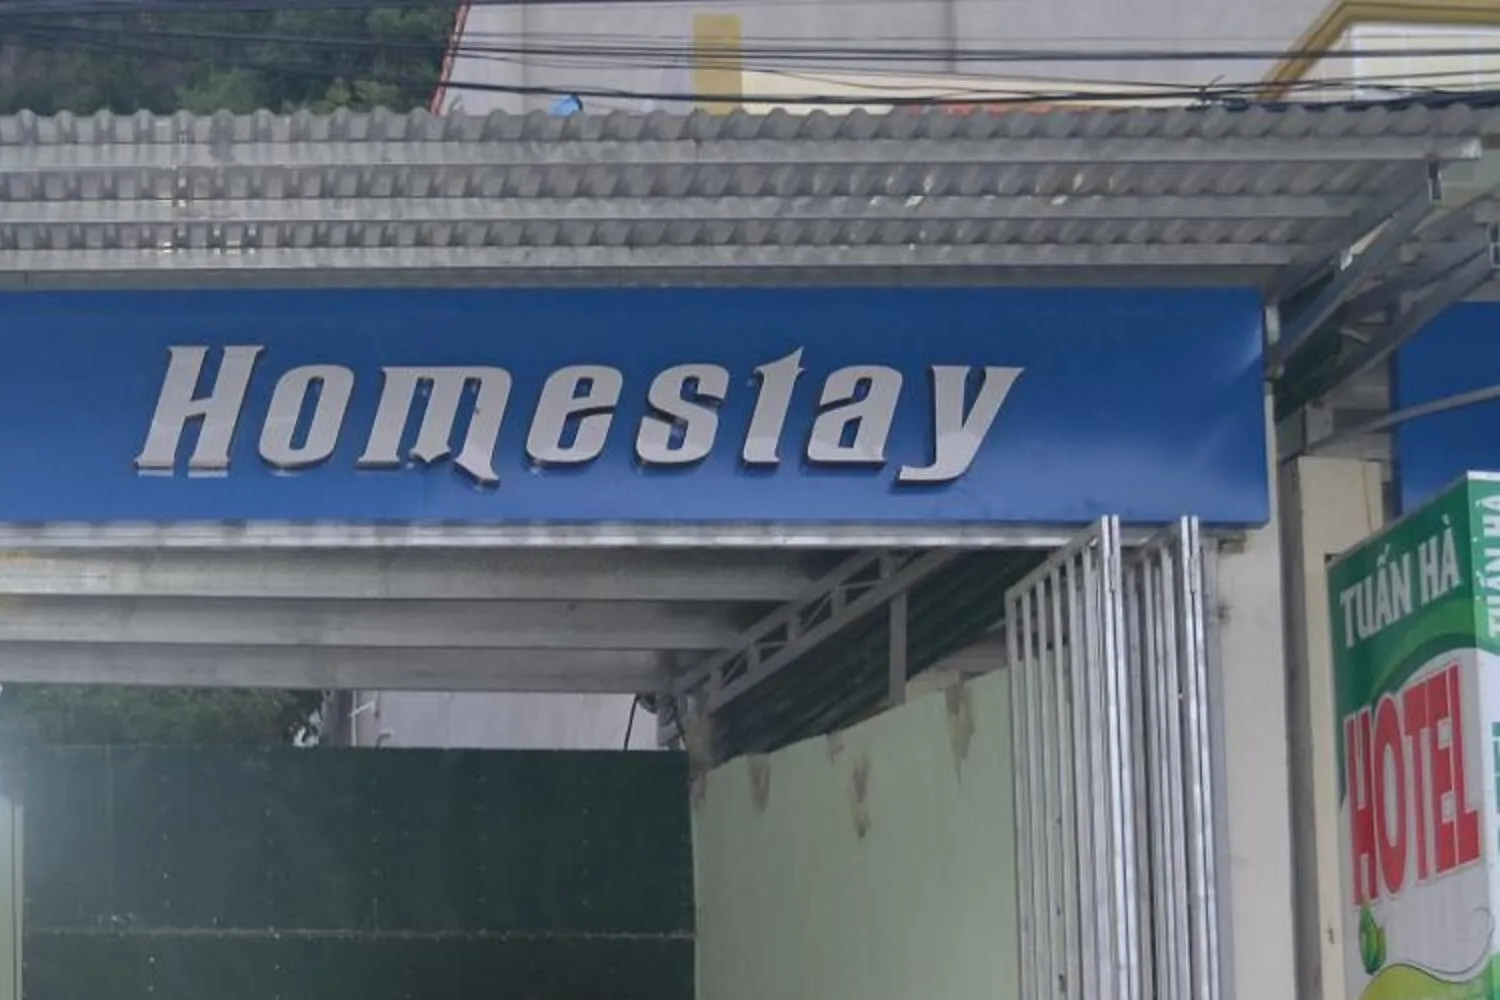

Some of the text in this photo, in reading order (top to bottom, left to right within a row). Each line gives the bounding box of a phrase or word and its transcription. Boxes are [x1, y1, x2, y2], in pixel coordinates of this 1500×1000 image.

[133, 344, 1027, 484] Homestay
[1418, 513, 1461, 607] HÀ
[1343, 662, 1481, 906] HOTEL
